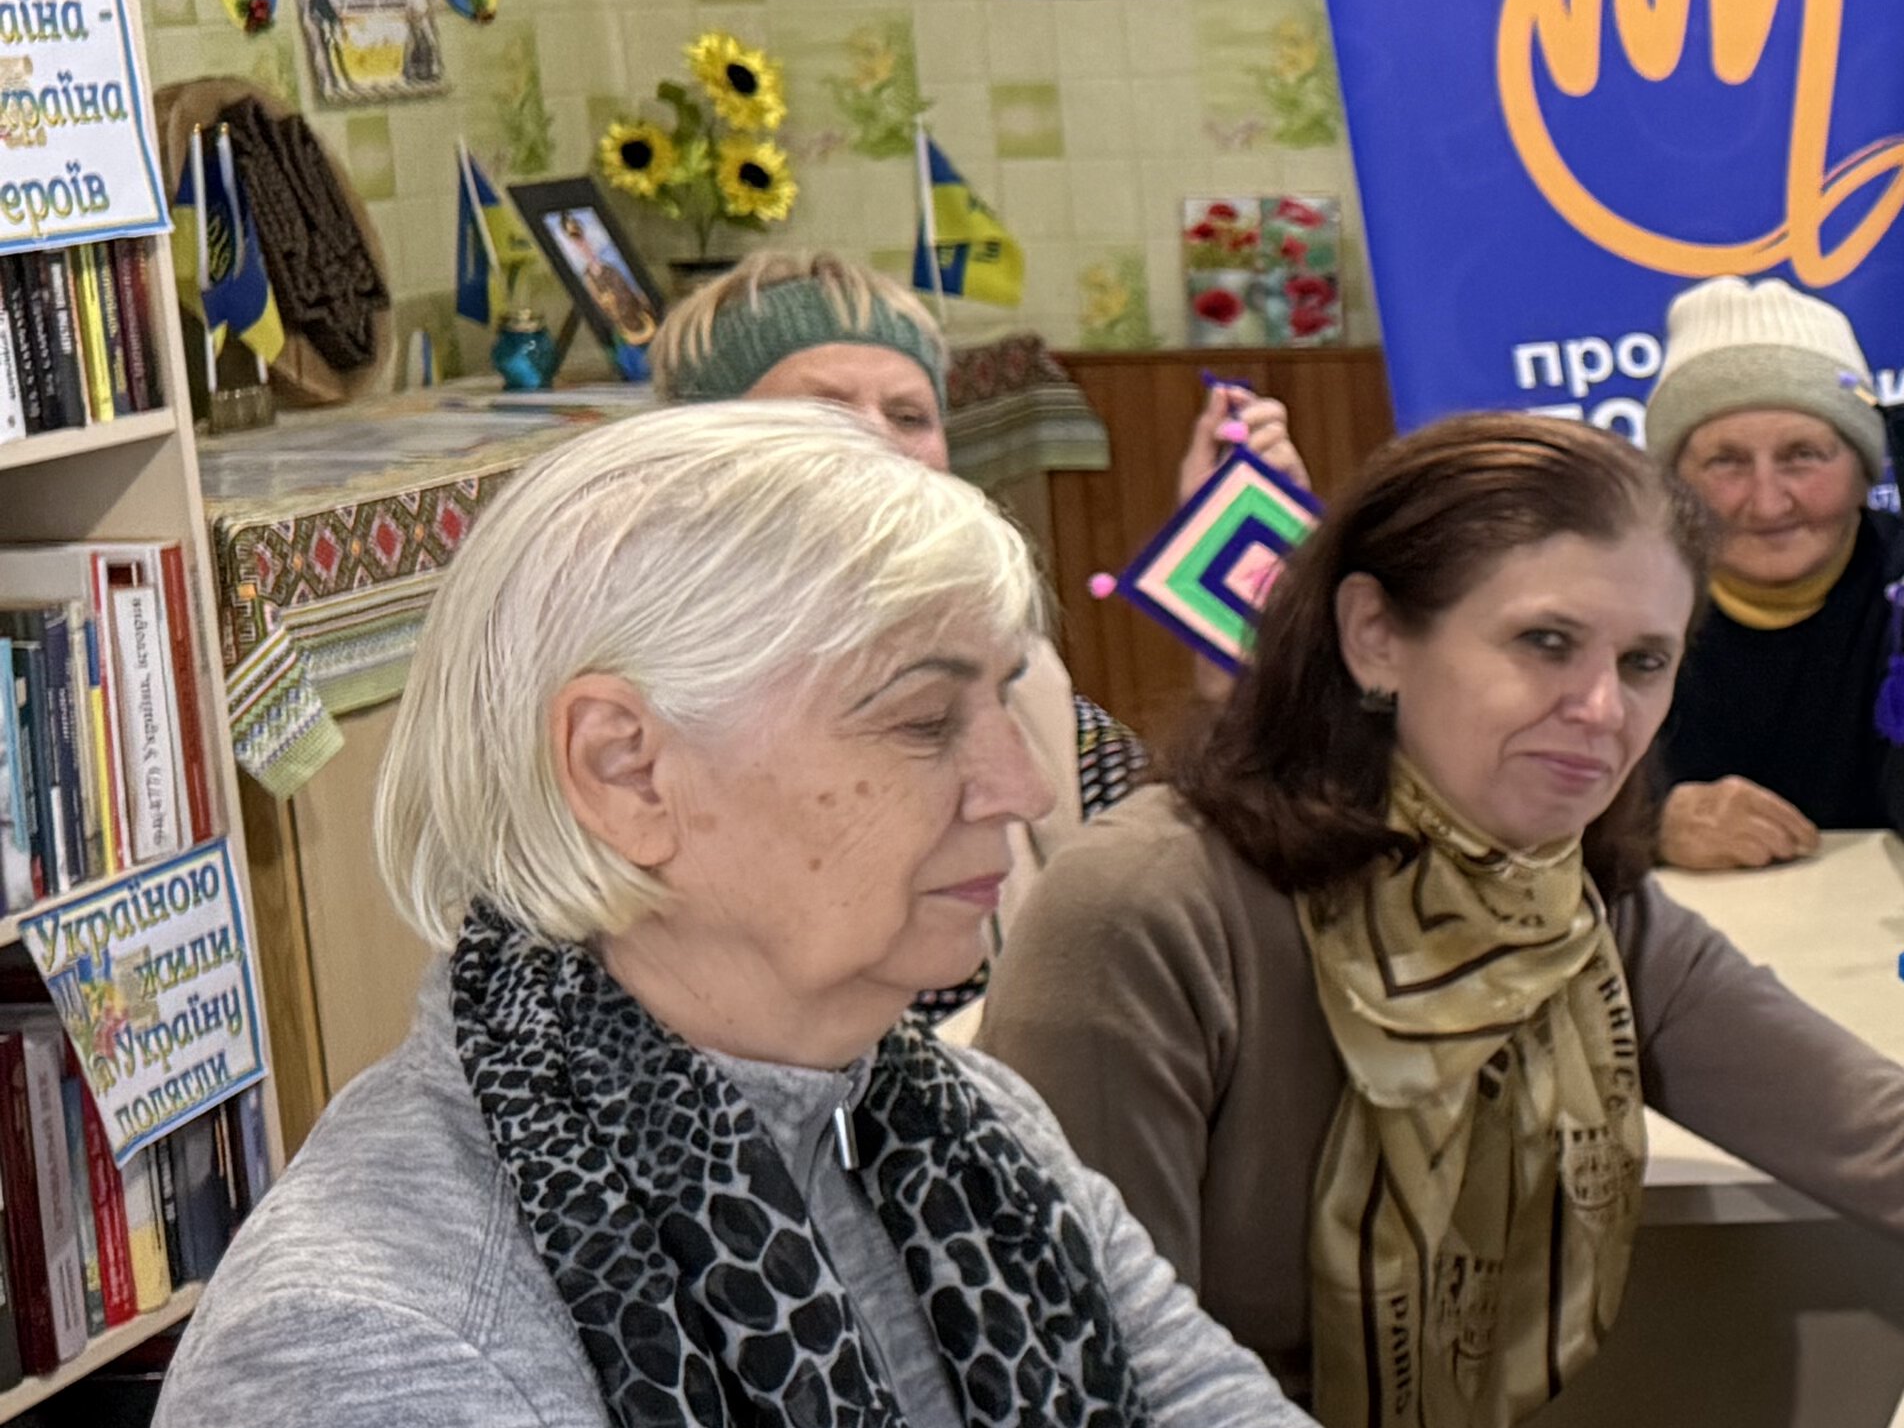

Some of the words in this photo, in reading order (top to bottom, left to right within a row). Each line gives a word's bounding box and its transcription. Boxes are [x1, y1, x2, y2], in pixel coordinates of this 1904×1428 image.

[0, 159, 111, 234] ероїв
[1513, 331, 1663, 399] про
[34, 860, 221, 973] Україною
[114, 985, 244, 1080] Україну
[113, 1048, 232, 1142] полягли
